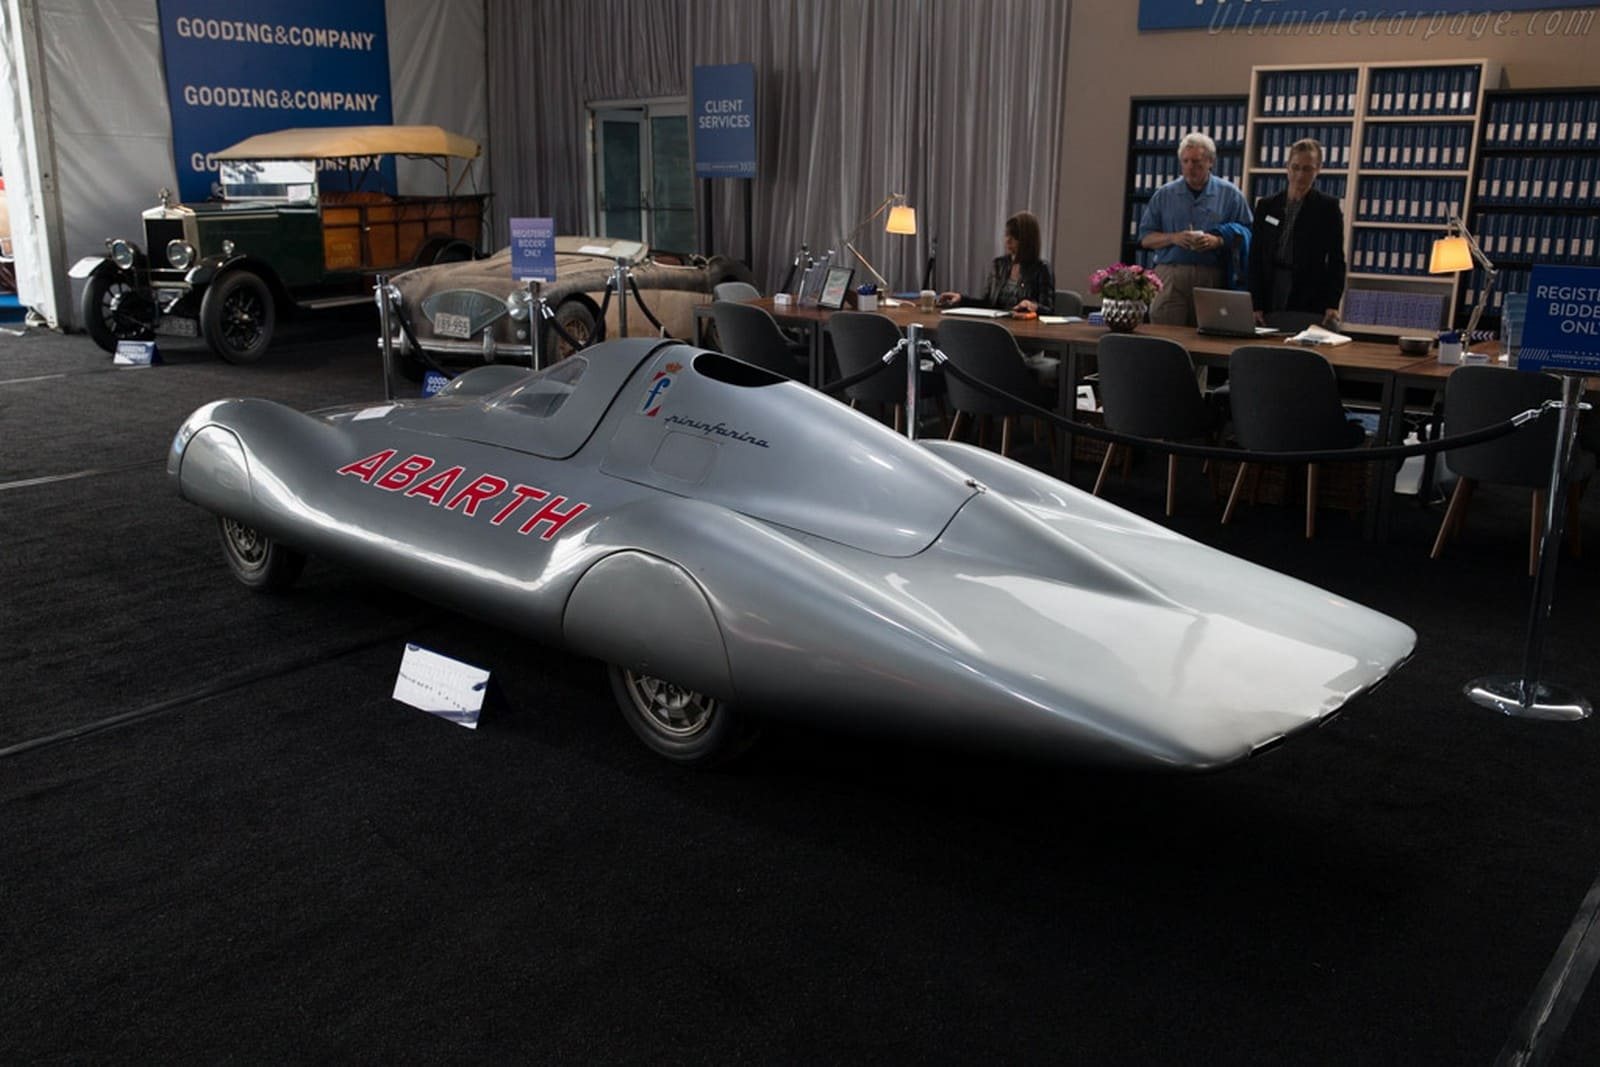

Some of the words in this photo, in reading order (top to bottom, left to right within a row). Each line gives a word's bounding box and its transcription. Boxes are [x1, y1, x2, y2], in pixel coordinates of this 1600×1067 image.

[177, 17, 374, 50] GOODING&COMPANY
[184, 85, 379, 112] GOODING&COMPANY
[704, 99, 743, 113] CLIENT
[699, 114, 751, 129] SERVICES
[336, 449, 591, 541] ABARTH
